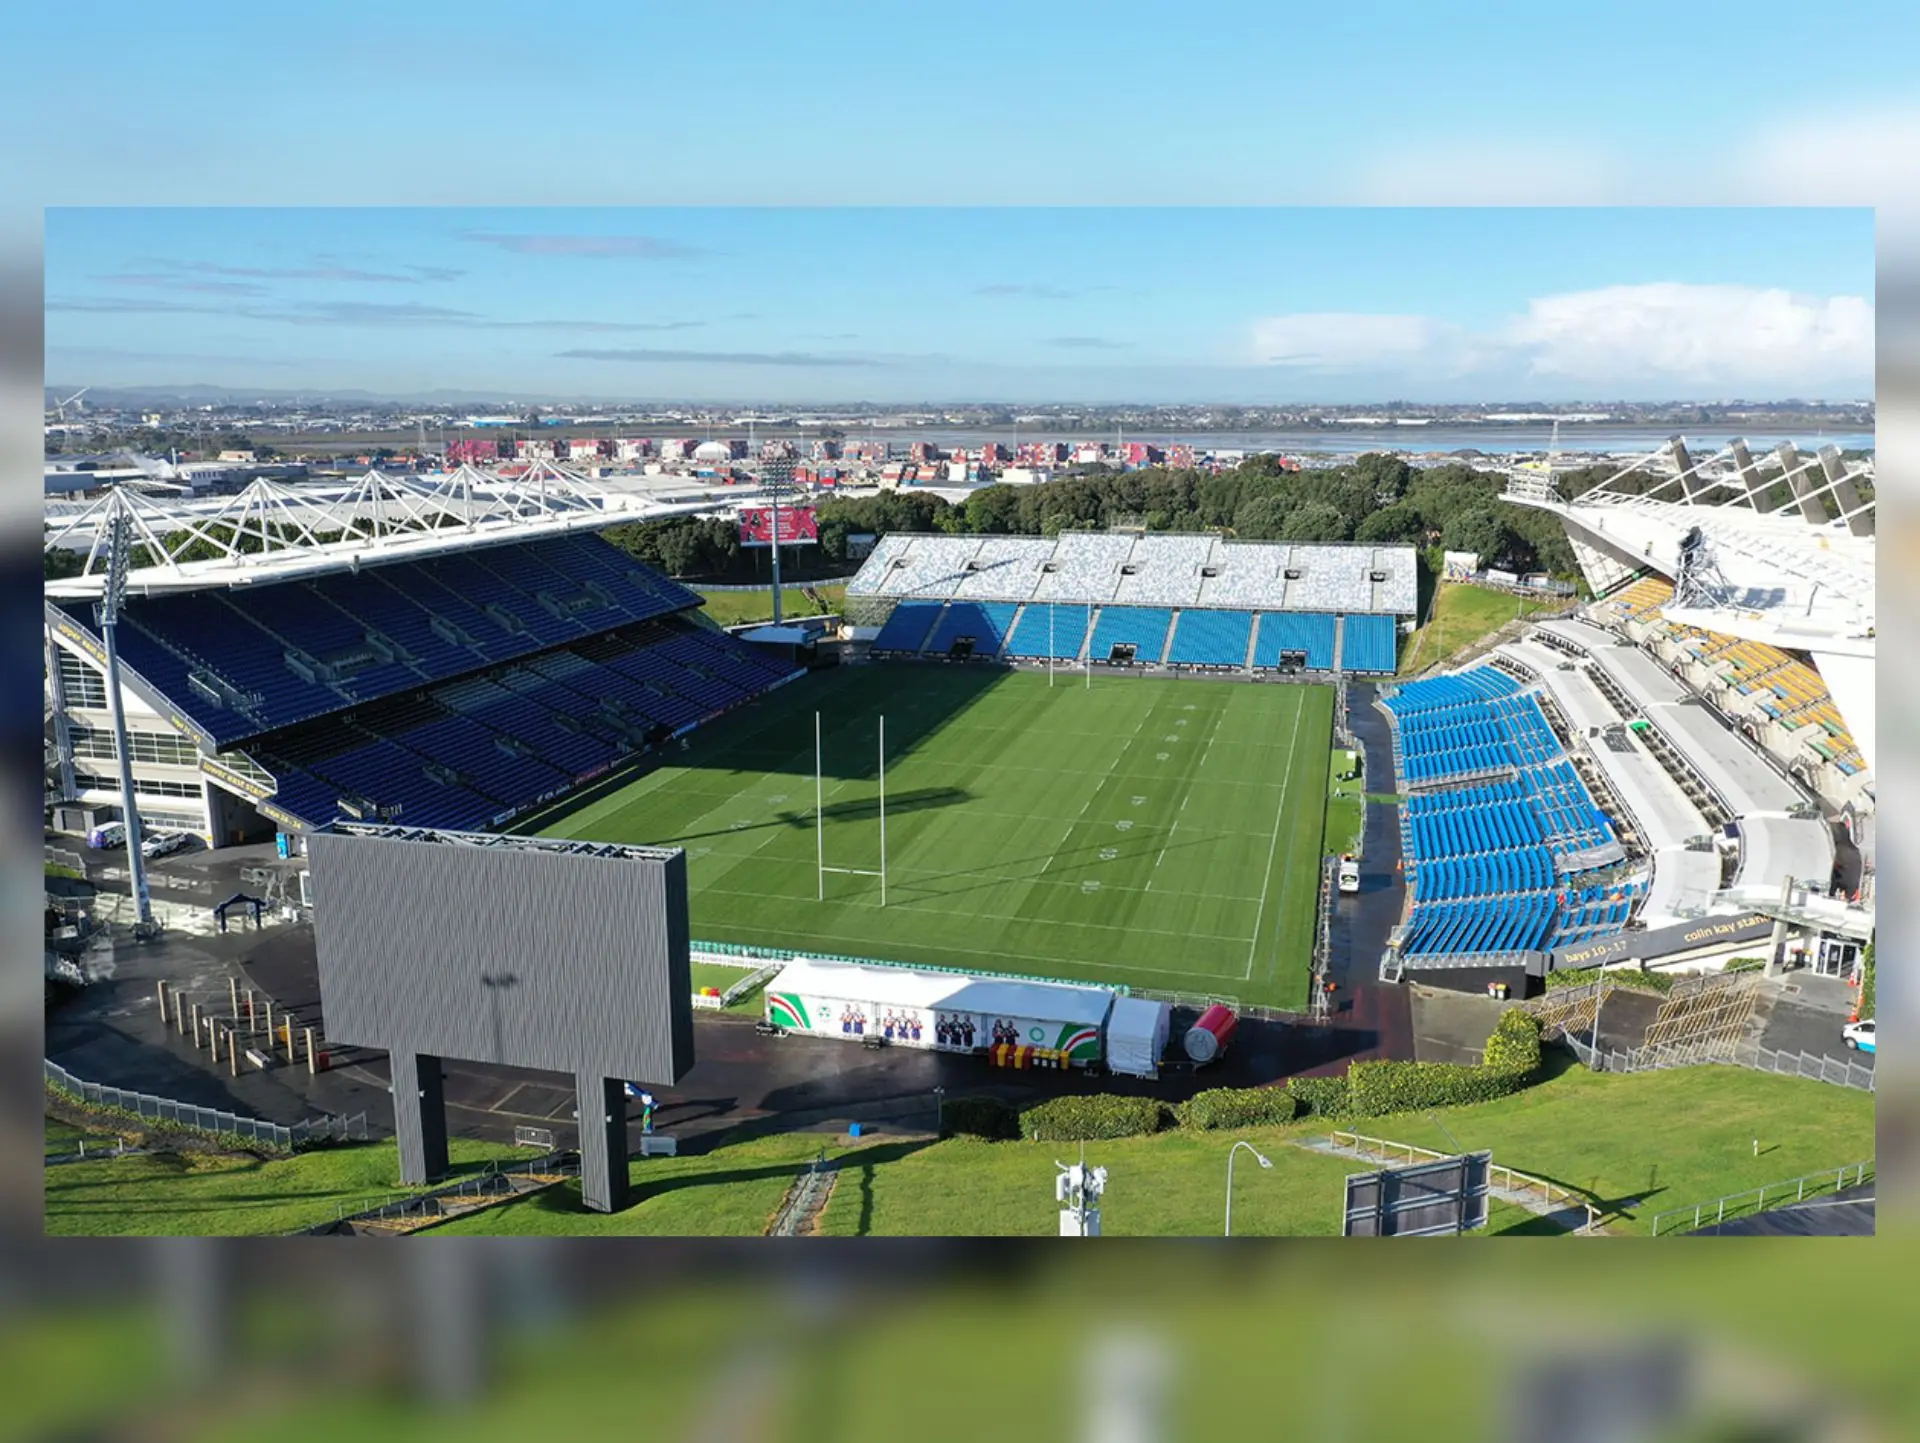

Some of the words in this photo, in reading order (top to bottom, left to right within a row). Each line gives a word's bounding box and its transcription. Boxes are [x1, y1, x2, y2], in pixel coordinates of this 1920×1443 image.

[1684, 927, 1713, 943] colin
[1713, 921, 1737, 936] kay
[1564, 949, 1590, 963] bays
[1591, 943, 1606, 957] 10
[1613, 940, 1627, 952] 17
